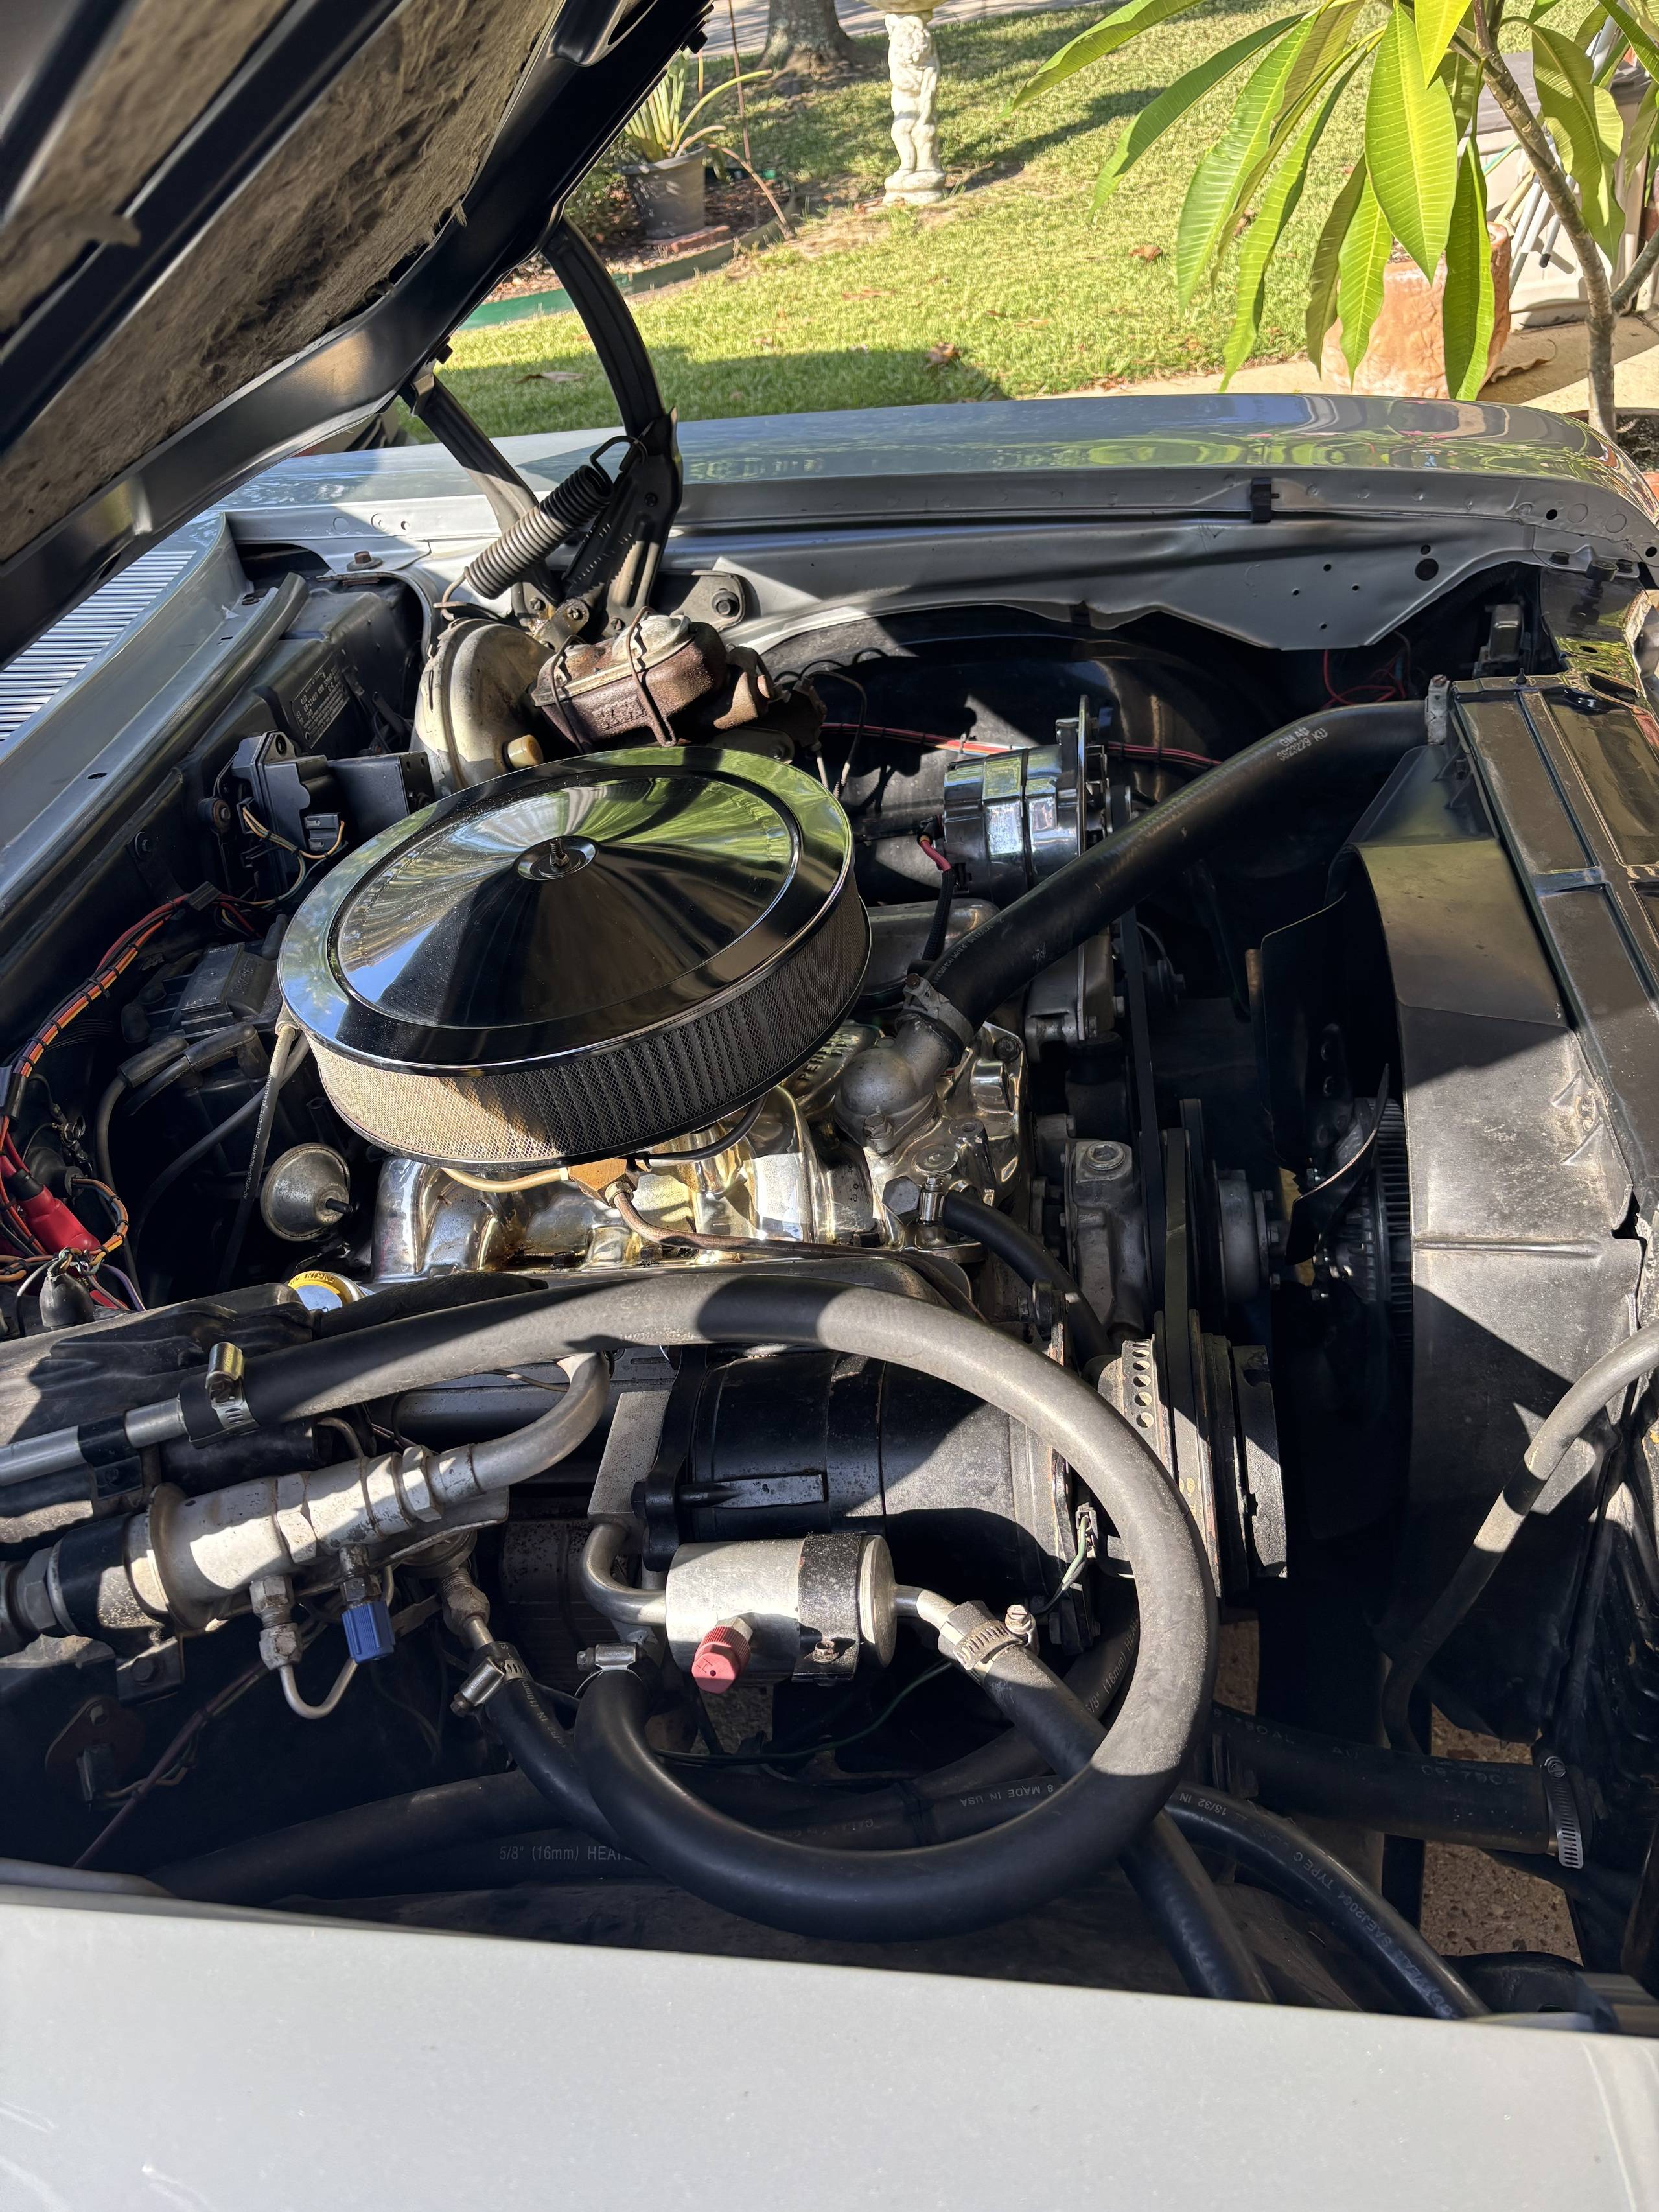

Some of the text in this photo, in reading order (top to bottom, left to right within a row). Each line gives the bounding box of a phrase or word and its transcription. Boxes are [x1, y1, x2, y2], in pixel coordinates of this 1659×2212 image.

[1279, 733, 1296, 747] GM
[1277, 738, 1312, 762] 3923229
[255, 1110, 265, 1139] DELCORE
[304, 1273, 335, 1282] ENGIN
[1102, 1652, 1126, 1694] (16mm)
[536, 1710, 548, 1723] IN
[989, 1790, 1001, 1801] IN
[1006, 1784, 1041, 1799] MADE
[958, 1794, 984, 1807] USA
[1179, 1793, 1227, 1815] 13/32 IN
[499, 1845, 524, 1860] 5/8"
[531, 1845, 579, 1861] (16mm)
[1292, 1851, 1304, 1863] C
[1303, 1860, 1332, 1891] TYPE
